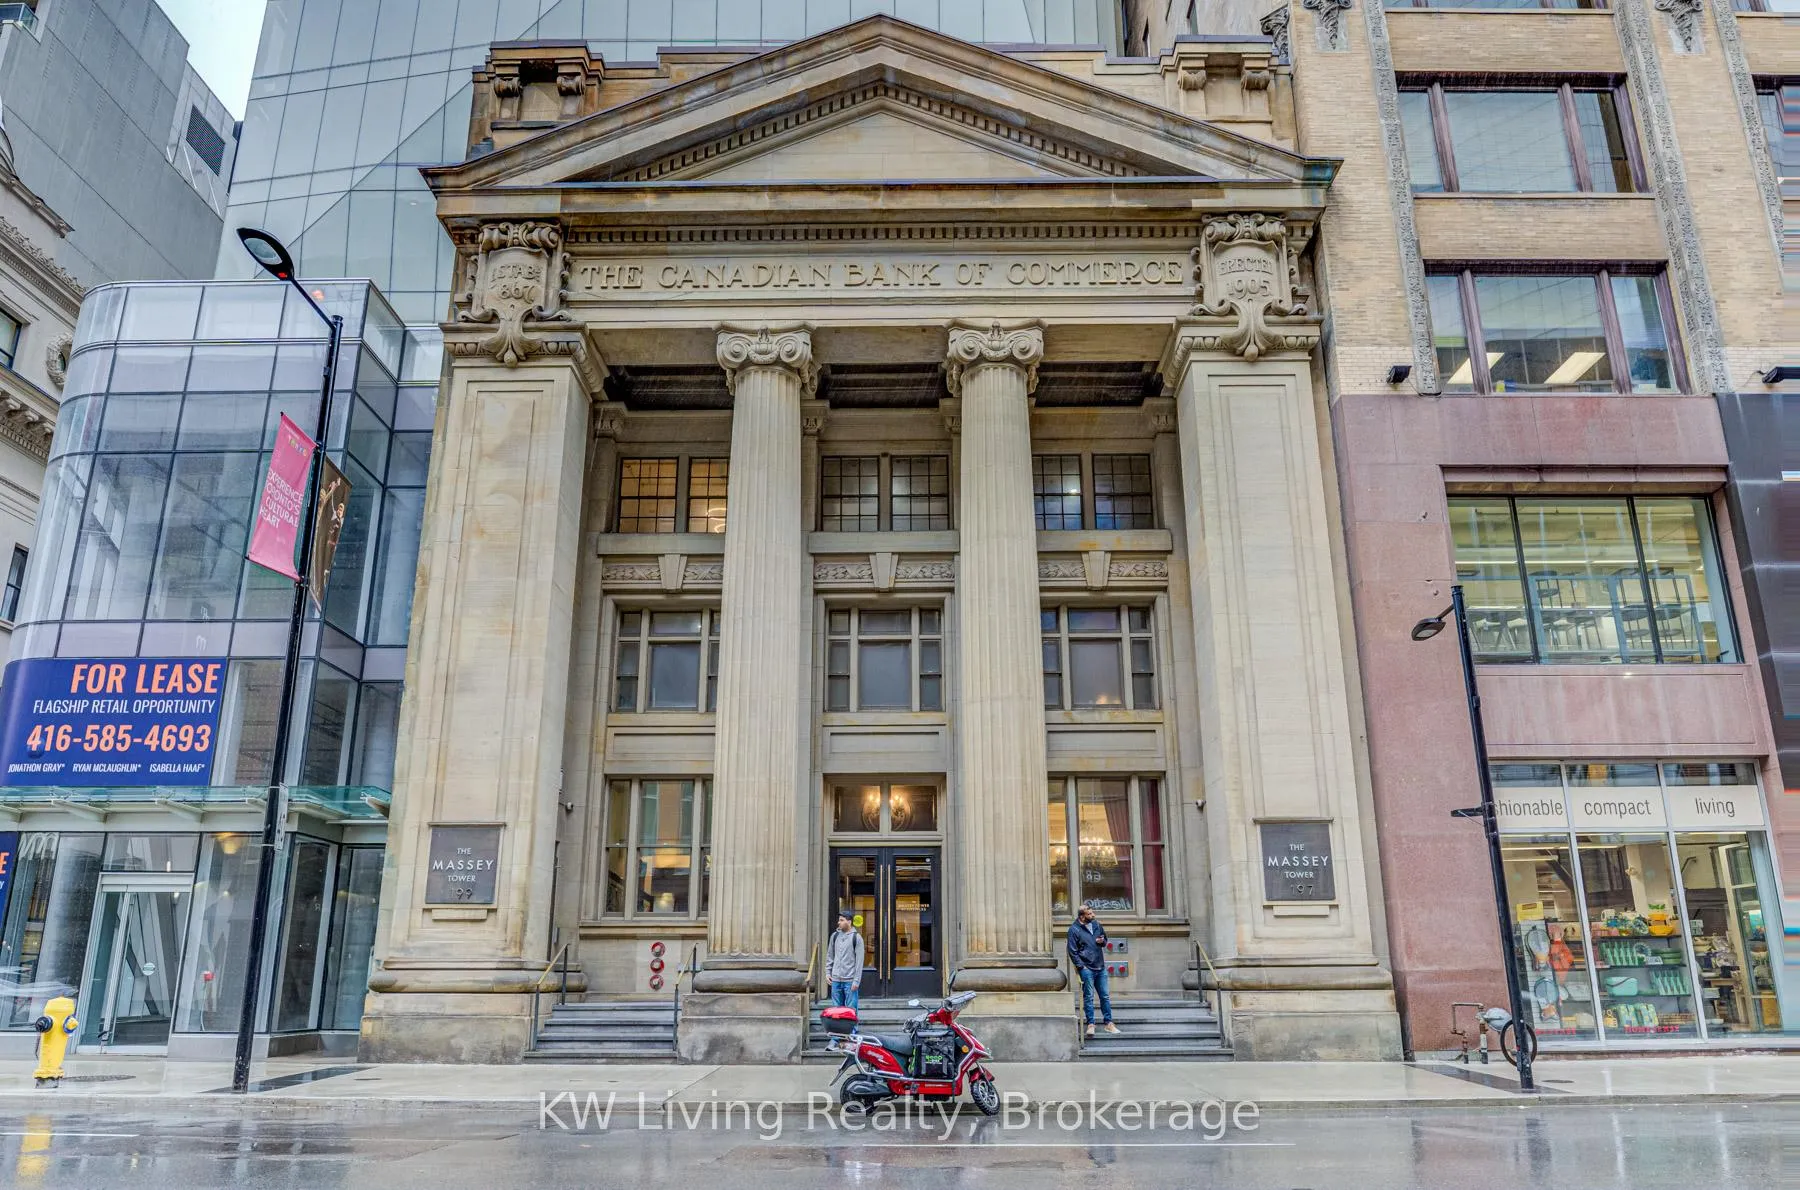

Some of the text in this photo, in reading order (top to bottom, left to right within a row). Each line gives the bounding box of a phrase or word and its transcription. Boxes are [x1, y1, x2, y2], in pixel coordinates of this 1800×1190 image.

[580, 261, 1183, 290] THE CANADIAN BANK OF COMMERCE
[1226, 279, 1271, 299] 1905
[267, 467, 304, 504] EXPERIENCE
[259, 505, 280, 529] HEART
[265, 496, 299, 528] CULTURAL
[70, 663, 221, 694] FOR LEASE
[33, 699, 216, 714] FLAGSHIP RETAIL OPPORTUNITY
[27, 724, 212, 752] 416-585-4693
[8, 763, 41, 773] JONATHON
[72, 763, 91, 773] RYAN
[149, 763, 181, 773] ISABELLA
[1584, 799, 1652, 820] compact
[1695, 797, 1735, 818] living
[457, 847, 472, 855] THE
[1289, 843, 1305, 851] THE
[432, 859, 494, 870] MASSEY
[1267, 856, 1329, 867] MASSEY
[1284, 871, 1315, 879] TOWER
[451, 887, 473, 900] 99
